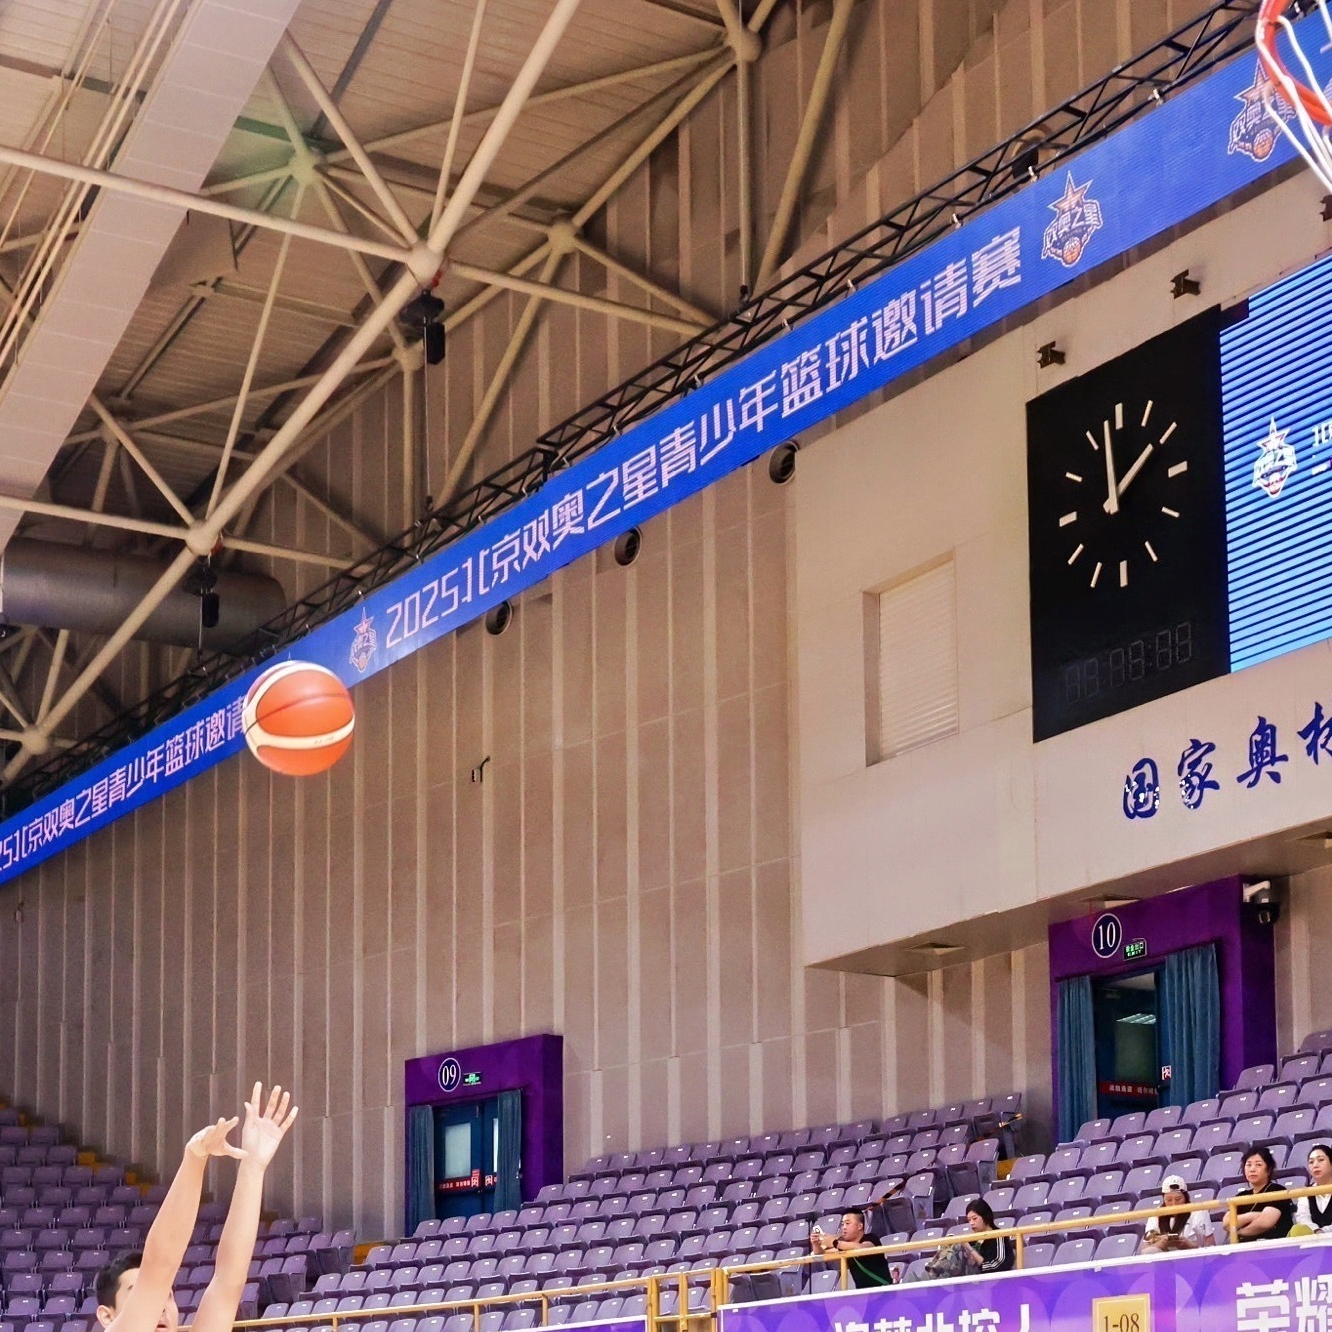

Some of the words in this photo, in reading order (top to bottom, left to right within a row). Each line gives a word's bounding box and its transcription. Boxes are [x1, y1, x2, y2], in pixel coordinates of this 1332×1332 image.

[385, 225, 1022, 650] 2025北京双奥之星青少年篮球邀请赛
[1098, 921, 1116, 950] 10
[441, 1064, 457, 1087] 09
